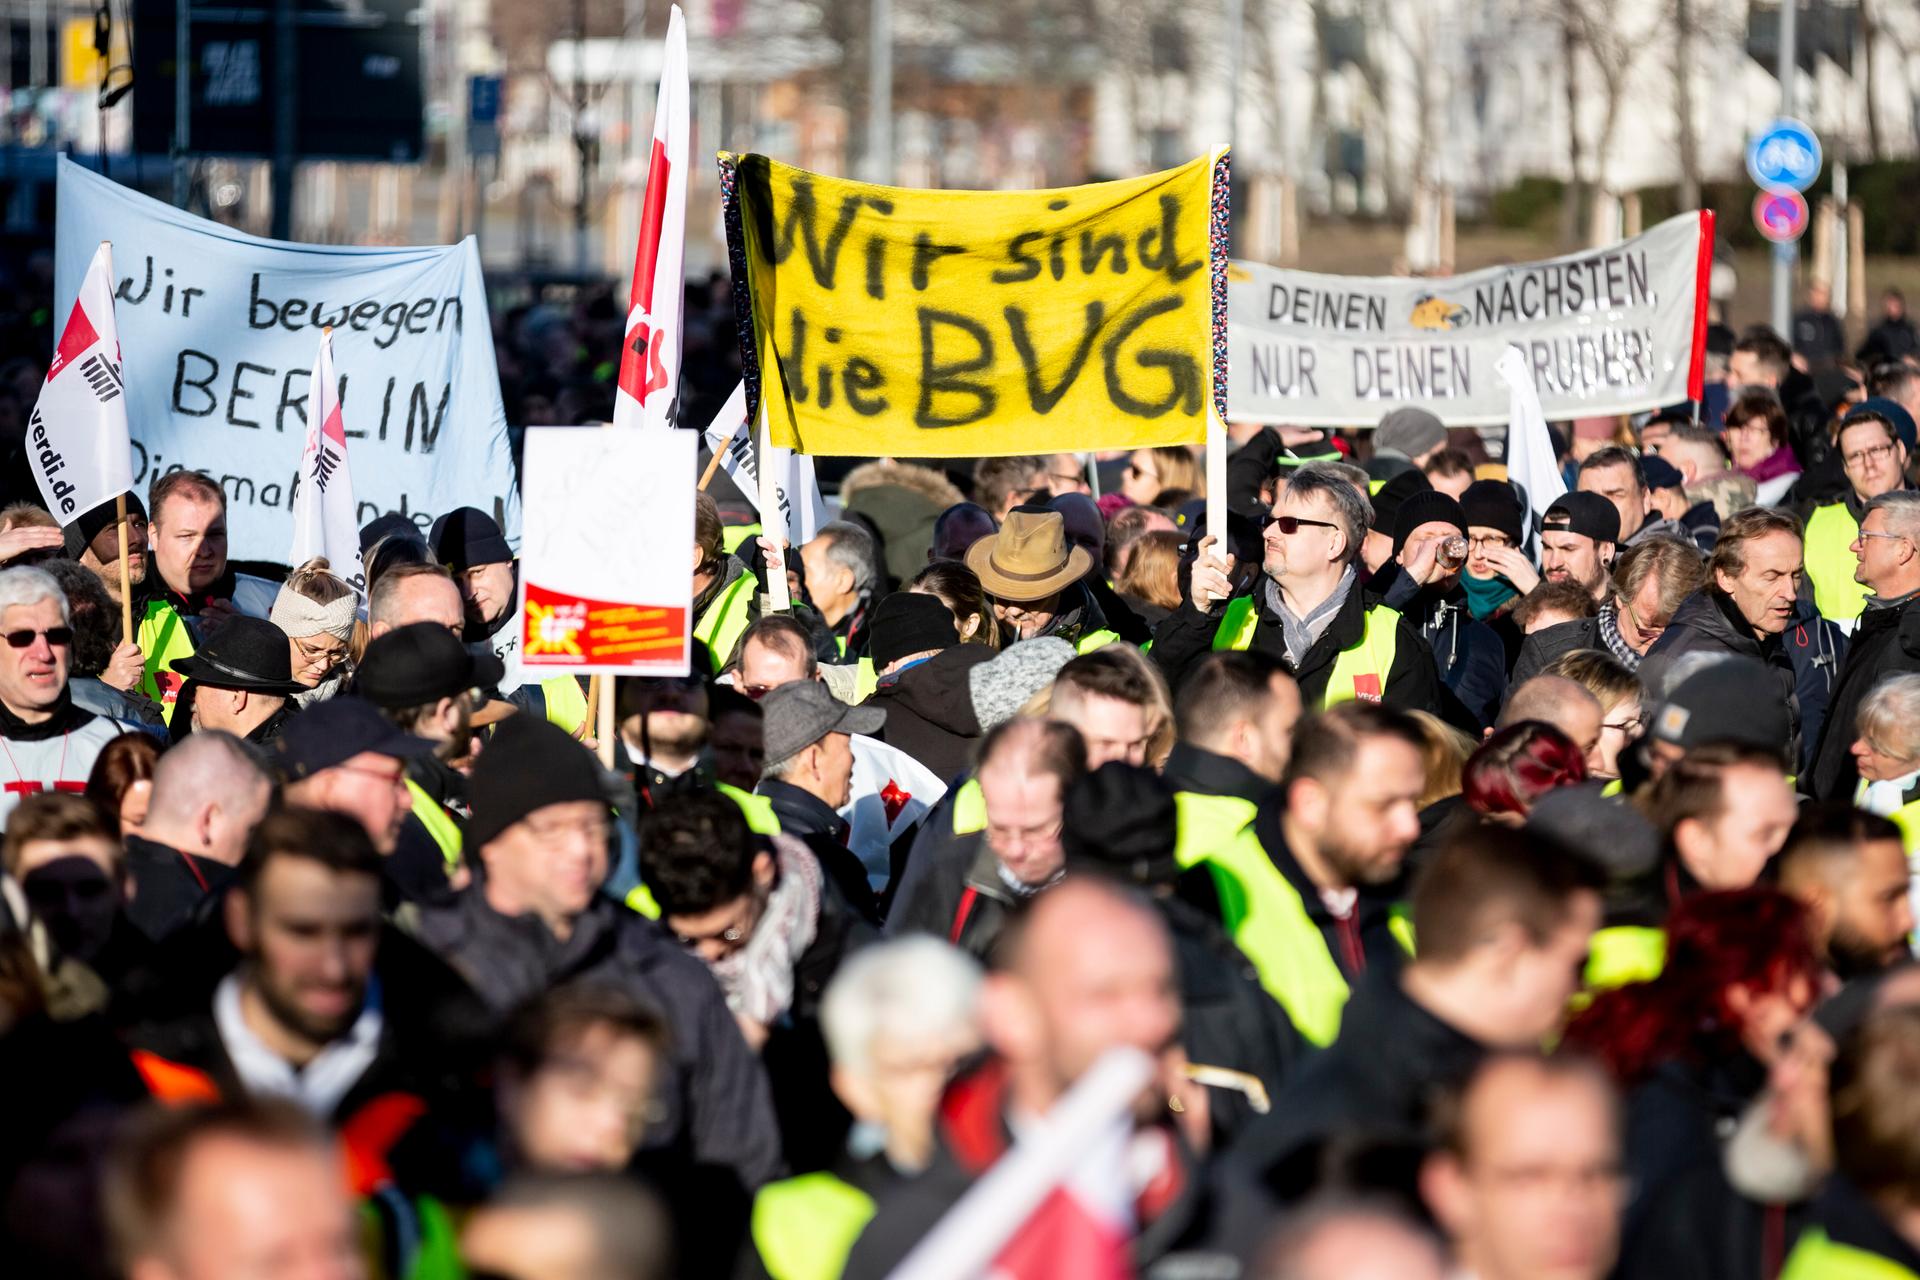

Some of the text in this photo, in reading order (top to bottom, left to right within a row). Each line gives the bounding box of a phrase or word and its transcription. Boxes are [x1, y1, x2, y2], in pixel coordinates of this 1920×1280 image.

[769, 175, 1204, 300] Wir sind
[114, 255, 464, 349] Wir bewegen
[1268, 283, 1387, 332] DEINEN
[172, 349, 453, 454] BERLIN
[914, 294, 1205, 430] BVG
[1252, 343, 1318, 396] NUR
[1353, 345, 1471, 398] DEINEN
[29, 408, 77, 516] verdi.de
